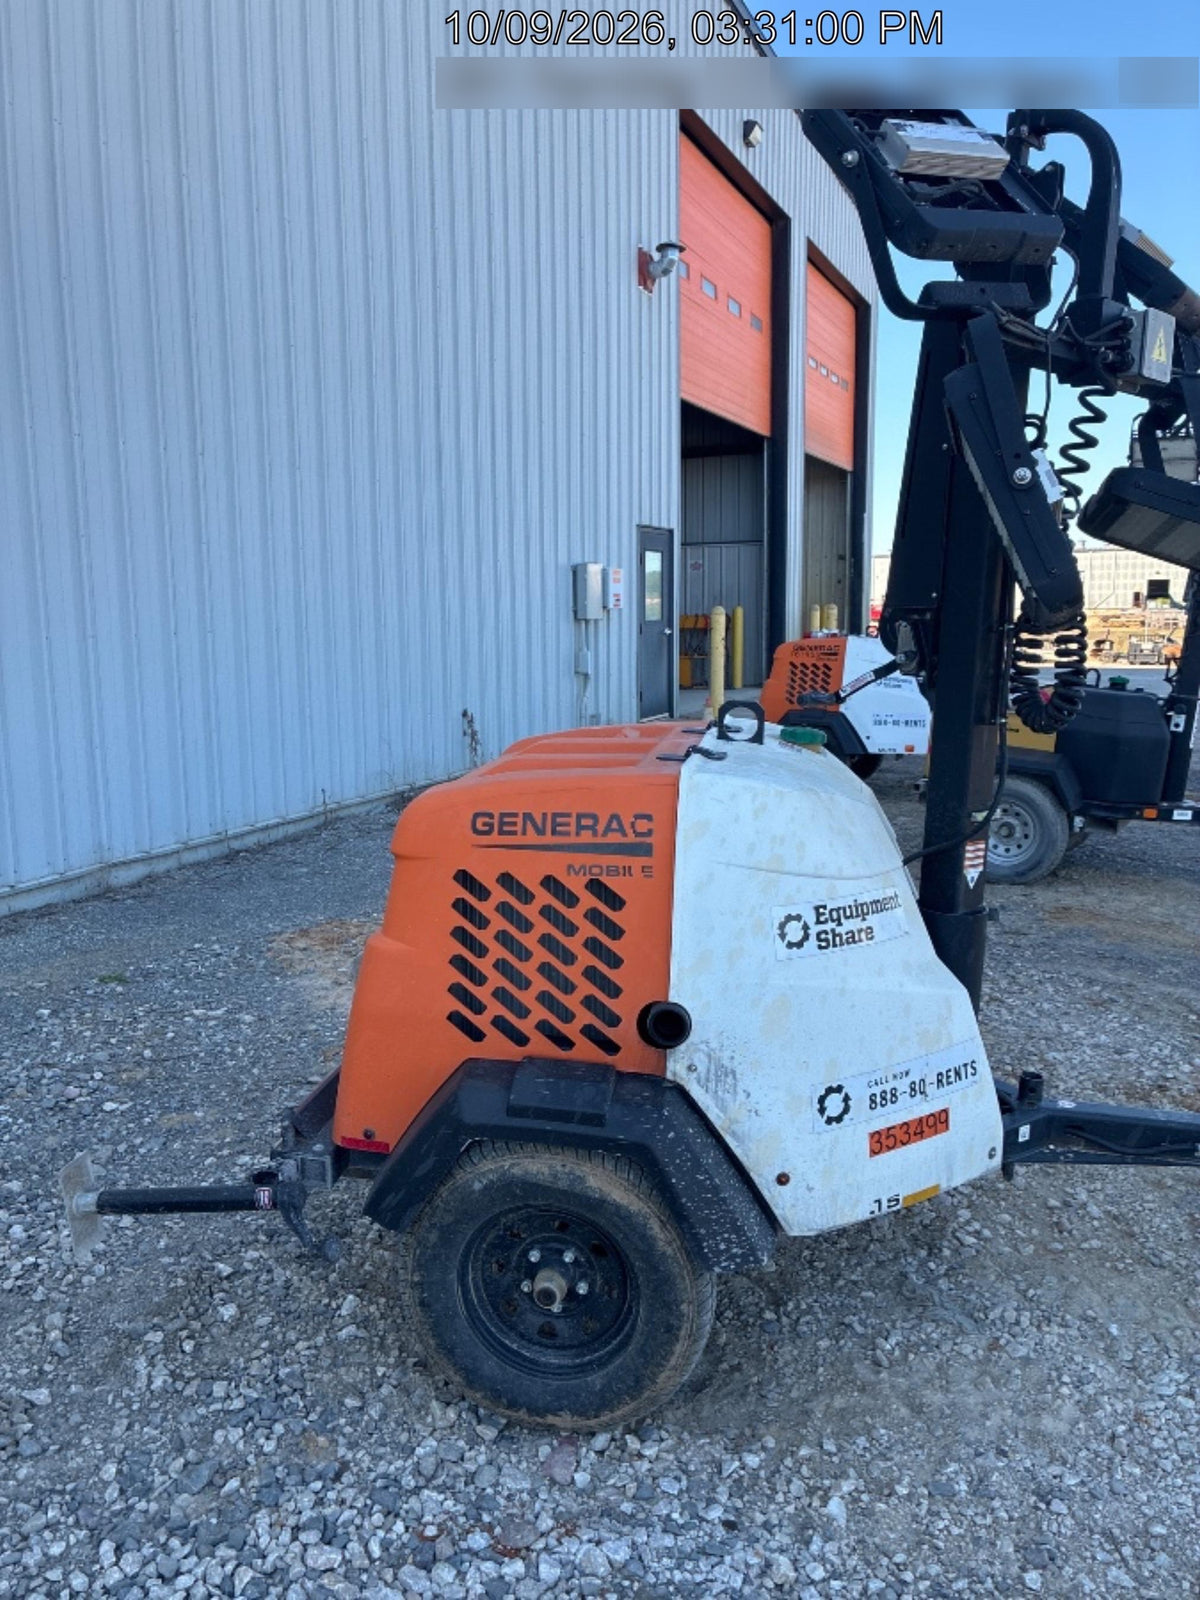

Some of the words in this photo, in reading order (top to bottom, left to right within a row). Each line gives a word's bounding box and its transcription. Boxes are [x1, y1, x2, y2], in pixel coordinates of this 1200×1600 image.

[471, 812, 653, 838] GENERAC
[813, 890, 902, 927] Equipment
[815, 925, 875, 951] Share
[867, 1075, 889, 1089] CALL
[892, 1068, 911, 1081] NOW
[868, 1059, 978, 1111] 888-80-RENTS
[870, 1109, 949, 1156] 353499
